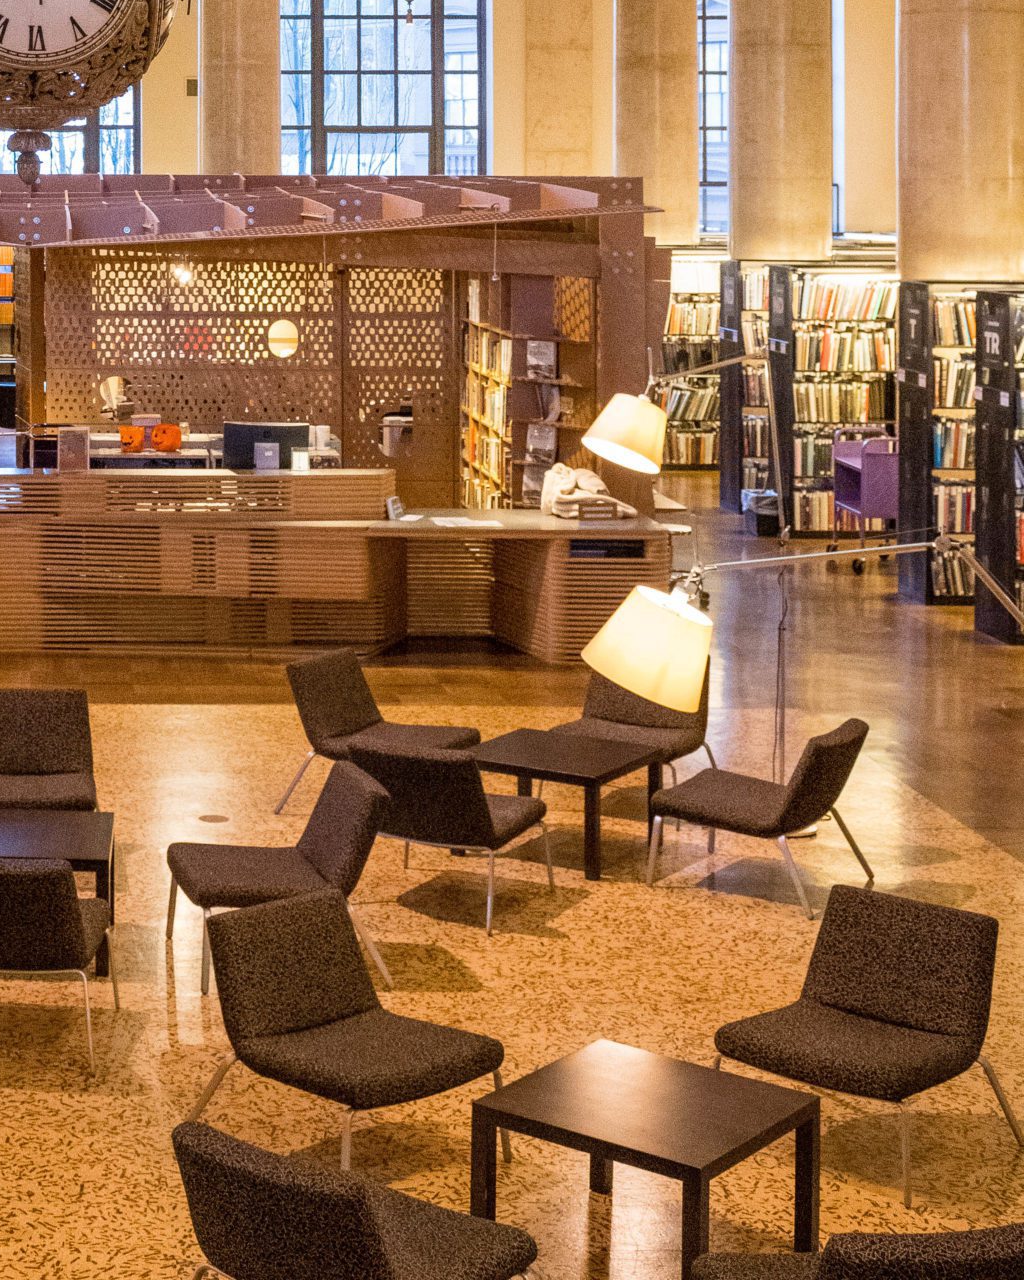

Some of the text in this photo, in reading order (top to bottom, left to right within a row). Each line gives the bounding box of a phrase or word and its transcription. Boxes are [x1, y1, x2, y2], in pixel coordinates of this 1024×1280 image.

[28, 25, 46, 51] VI
[70, 16, 88, 42] V
[909, 318, 917, 339] T
[984, 331, 1000, 355] TR
